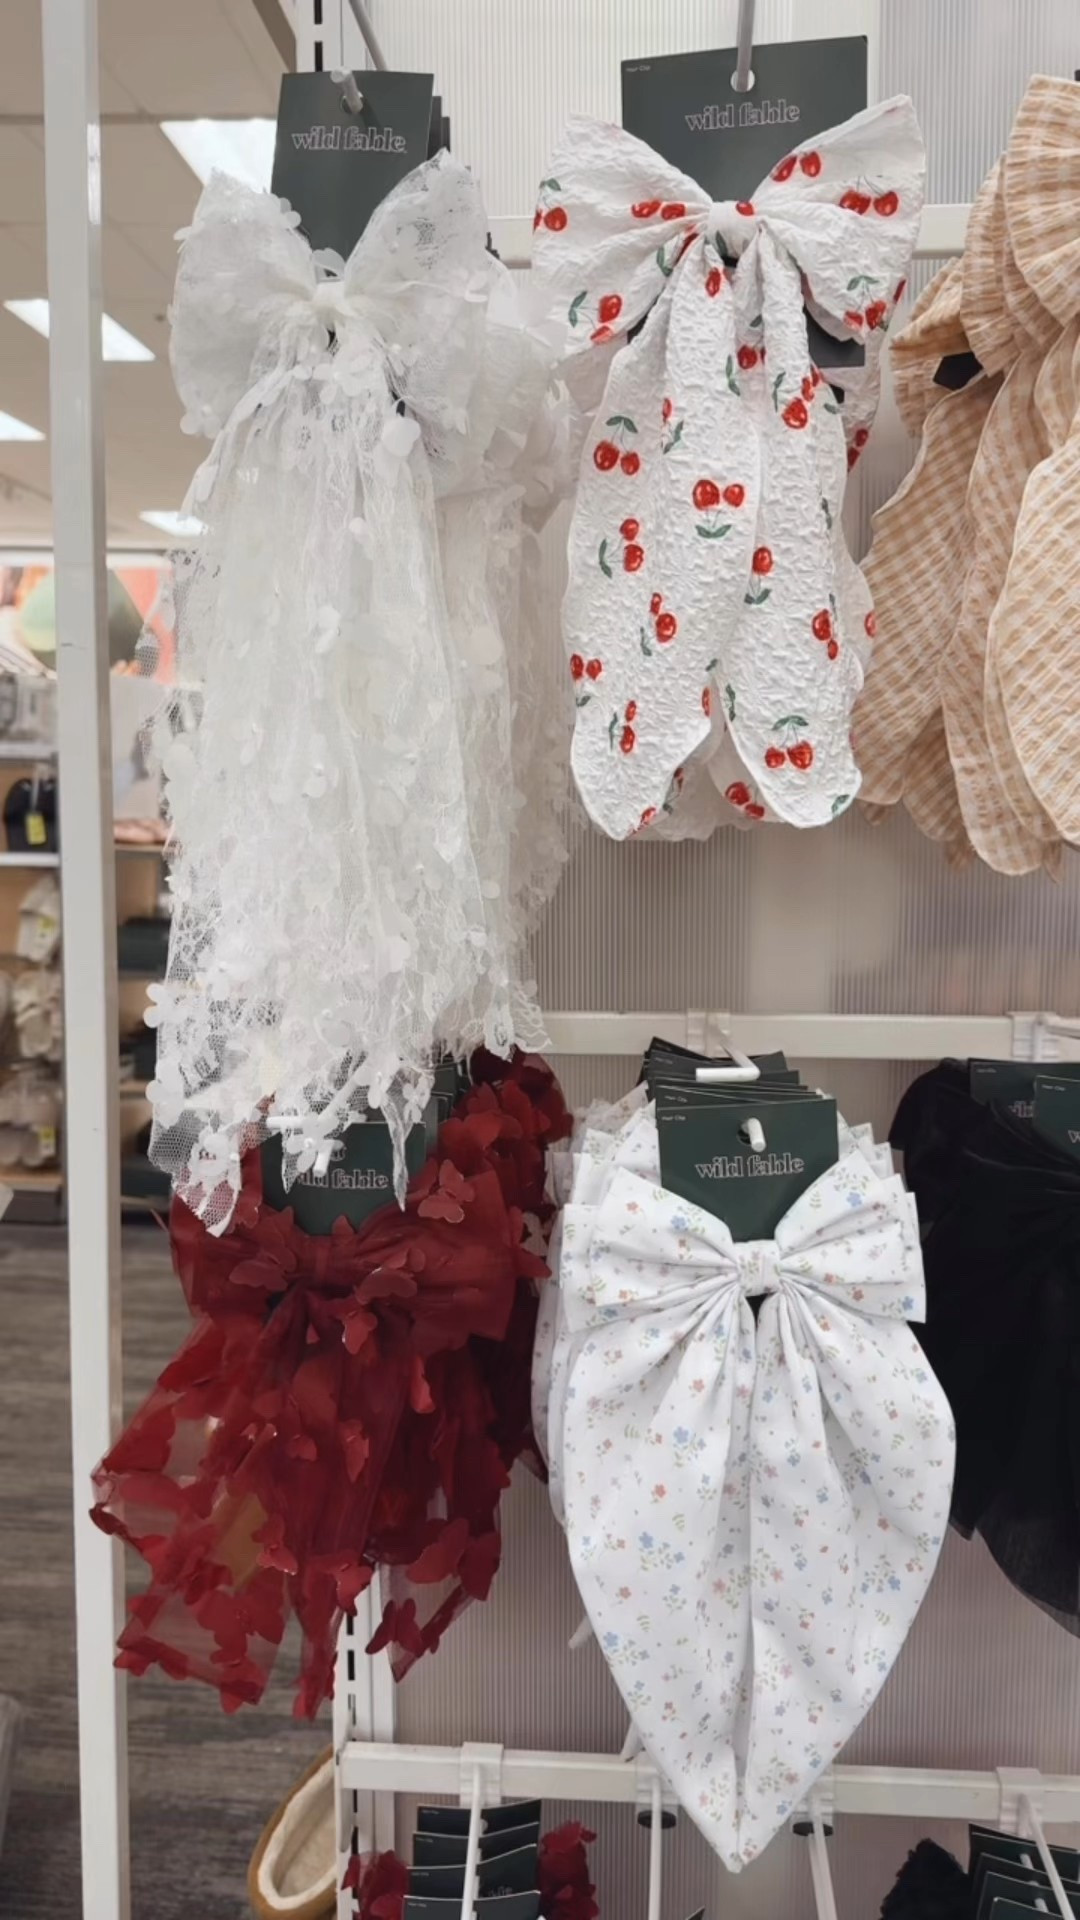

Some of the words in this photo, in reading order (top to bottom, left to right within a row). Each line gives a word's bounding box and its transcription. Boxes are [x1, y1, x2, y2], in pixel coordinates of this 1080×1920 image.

[685, 104, 735, 131] wild
[738, 99, 800, 128] fable
[291, 126, 341, 150] wild
[344, 126, 407, 153] fable
[297, 1168, 329, 1188] ild
[331, 1168, 389, 1190] fable
[694, 1156, 744, 1179] wild
[746, 1152, 805, 1177] fable
